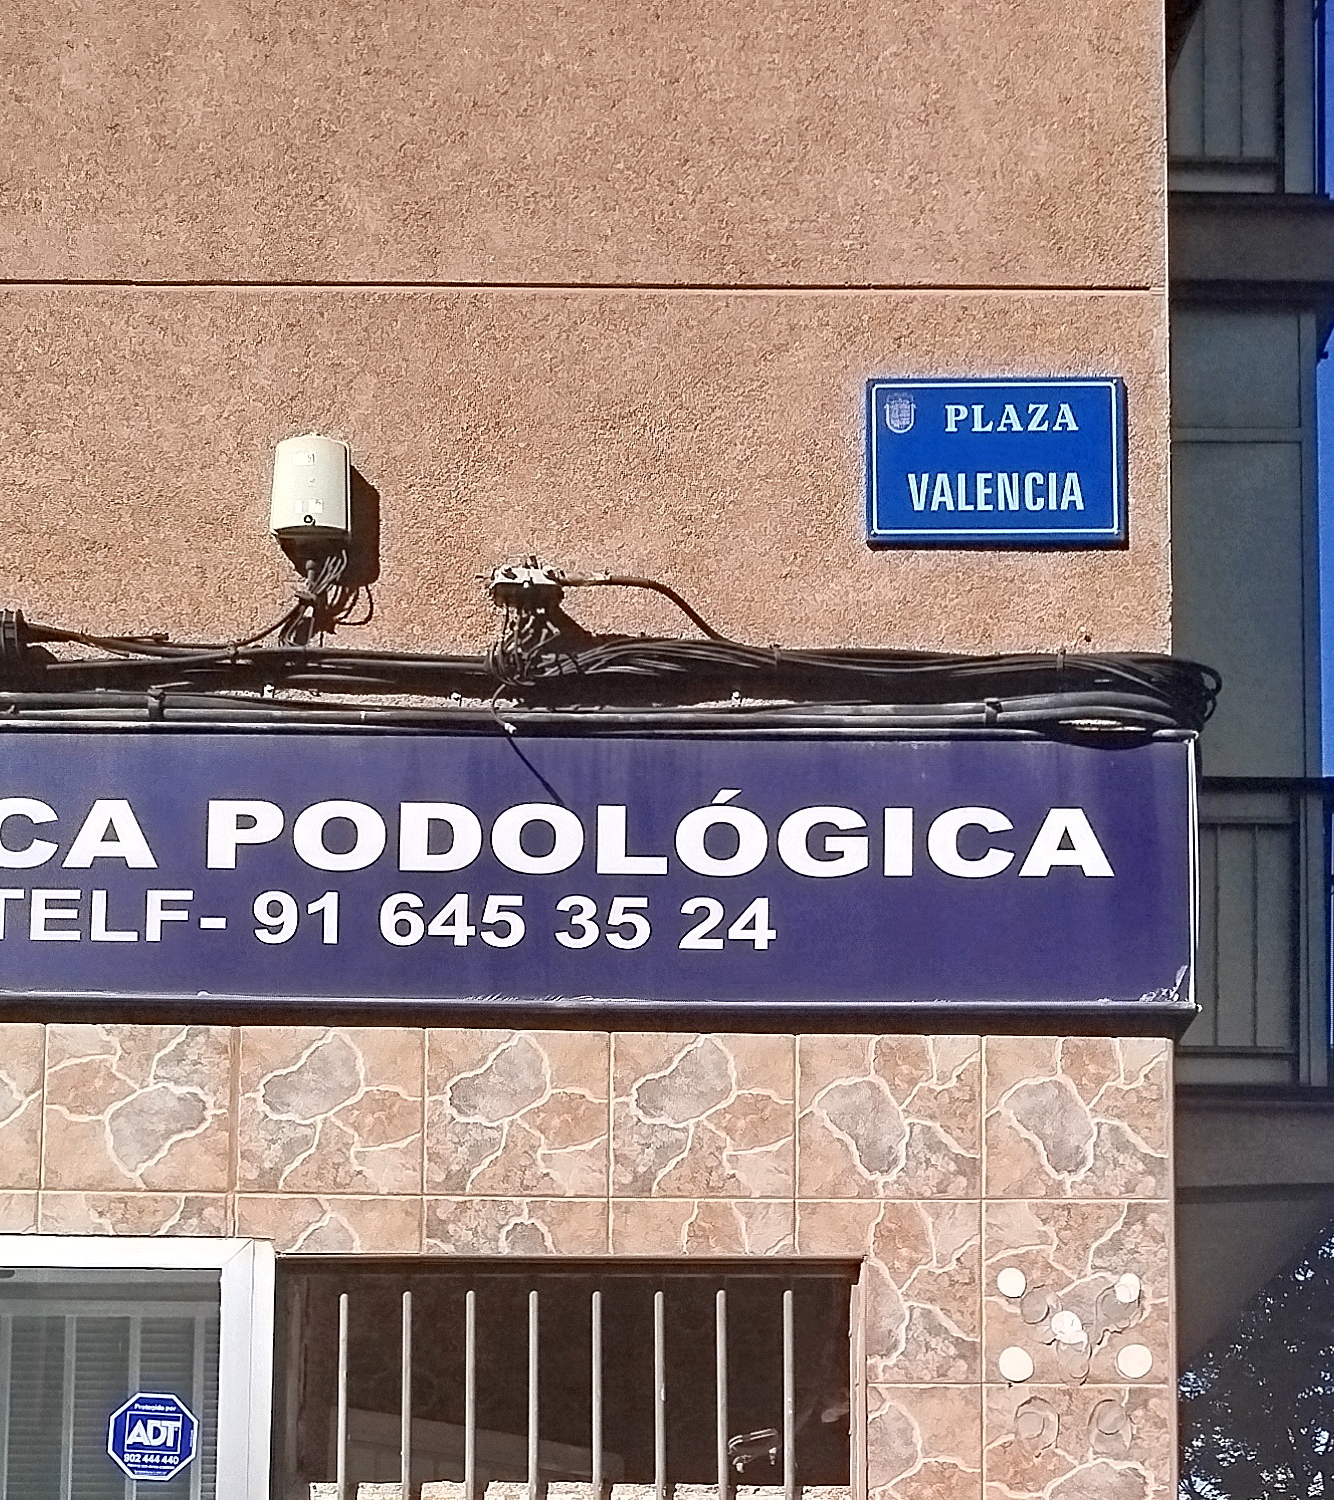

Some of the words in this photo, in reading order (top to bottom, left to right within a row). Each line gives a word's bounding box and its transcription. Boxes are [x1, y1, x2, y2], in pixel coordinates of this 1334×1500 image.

[944, 403, 1080, 433] PLAZA
[907, 472, 1086, 512] VALENCIA
[205, 788, 1117, 879] PODOLÓGICA
[252, 890, 340, 946] 91
[378, 892, 527, 948] 645
[554, 895, 652, 951] 35
[678, 897, 777, 951] 24
[127, 1418, 181, 1448] ADT
[123, 1453, 142, 1463] 902
[142, 1454, 161, 1464] 444
[161, 1455, 180, 1465] 440
